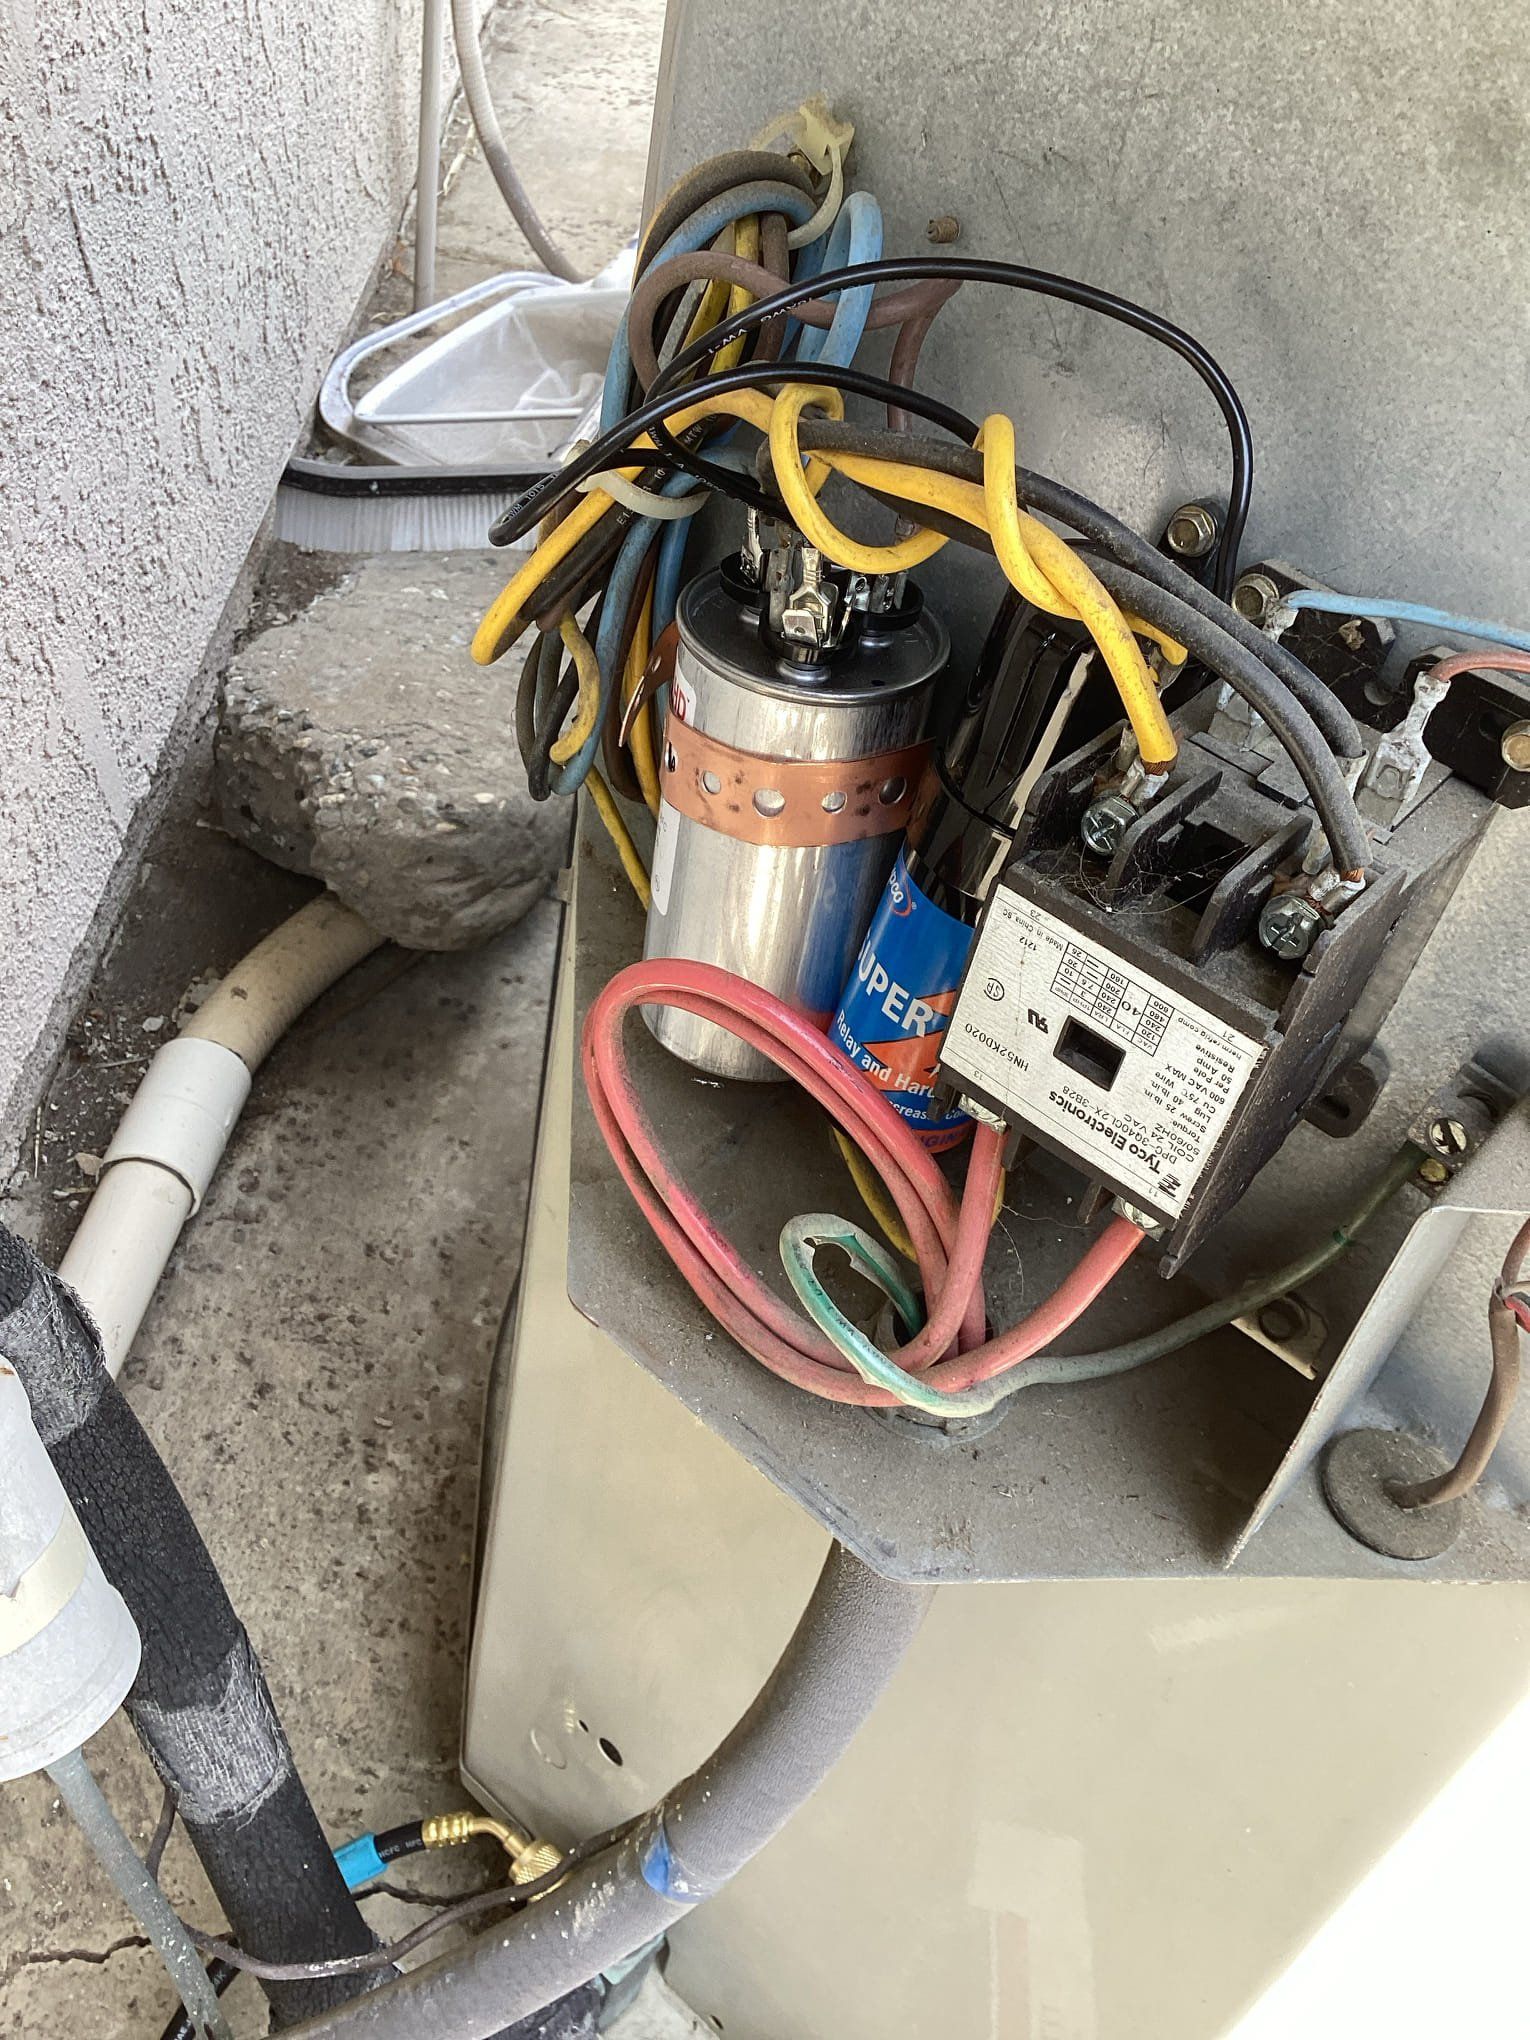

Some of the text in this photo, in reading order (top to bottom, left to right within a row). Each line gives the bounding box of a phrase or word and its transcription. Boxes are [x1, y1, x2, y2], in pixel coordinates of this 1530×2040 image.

[1029, 909, 1041, 921] 23
[1012, 915, 1033, 932] China
[1034, 928, 1043, 939] in
[1018, 935, 1039, 951] 1212
[1043, 935, 1063, 951] Made
[1064, 967, 1073, 976] 10
[1105, 982, 1120, 995] 200
[1121, 1000, 1141, 1015] 40
[1145, 1019, 1161, 1032] 240
[1175, 1017, 1199, 1032] comp
[1141, 1028, 1155, 1040] 120
[1222, 1030, 1235, 1042] 21
[836, 1008, 862, 1060] Relay
[861, 1048, 892, 1082] and
[1195, 1043, 1235, 1073] Resistive
[973, 1070, 985, 1080] 13
[1196, 1055, 1232, 1084] 50 Amp
[1154, 1071, 1174, 1088] Wire
[1164, 1062, 1225, 1104] 600 VAC MAX
[1193, 1066, 1230, 1094] Per Pole
[1164, 1103, 1176, 1113] 25
[1172, 1095, 1184, 1105] 40
[1202, 1101, 1216, 1114] Cu
[888, 1100, 931, 1120] creas
[1193, 1106, 1211, 1123] Lug
[1179, 1112, 1206, 1133] Screw
[1048, 1090, 1160, 1174] Tyco Electronics
[1123, 1113, 1196, 1162] COIL 24 VAC
[1154, 1122, 1200, 1155] 50/60HZ
